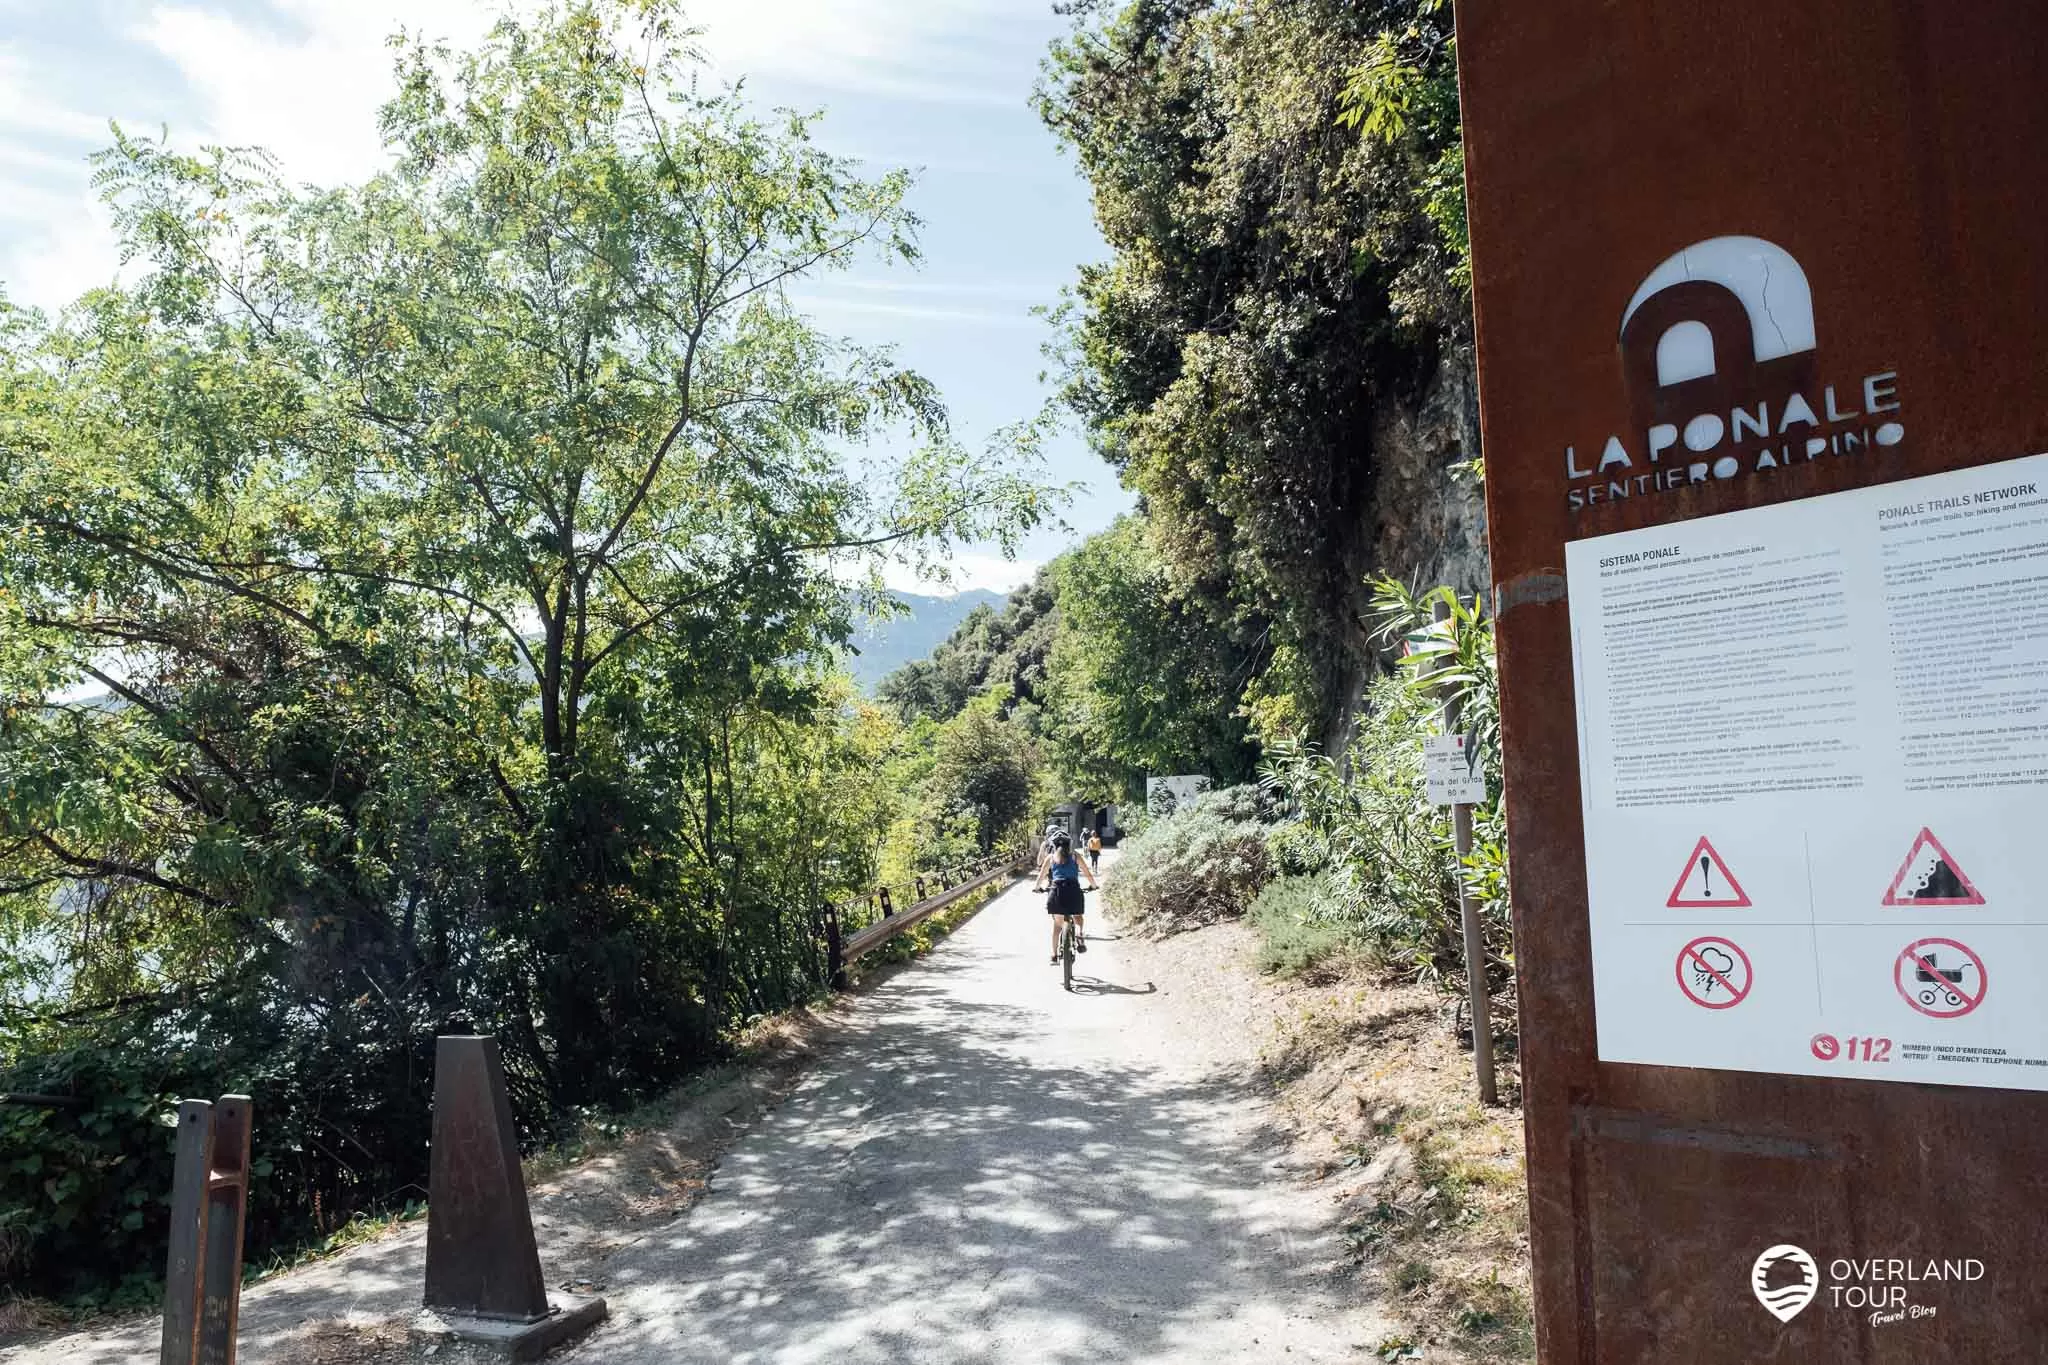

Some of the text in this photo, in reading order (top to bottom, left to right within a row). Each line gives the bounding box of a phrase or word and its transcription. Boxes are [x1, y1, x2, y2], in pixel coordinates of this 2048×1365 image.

[1566, 371, 1901, 480] LA PONALE
[1568, 422, 1905, 511] SENTIERO ALPINO
[1878, 483, 2037, 521] PONALE TRAILS NETWORK
[1976, 505, 2001, 516] hiking
[2002, 503, 2017, 511] and
[1599, 545, 1681, 569] SISTEMA PONALE
[1845, 1036, 1892, 1062] 112
[1902, 1043, 2007, 1055] NUMERO UNICO D'EMERGENZA
[1937, 1054, 1980, 1064] EMERGENCY
[1981, 1056, 2024, 1066] TELEPHONE
